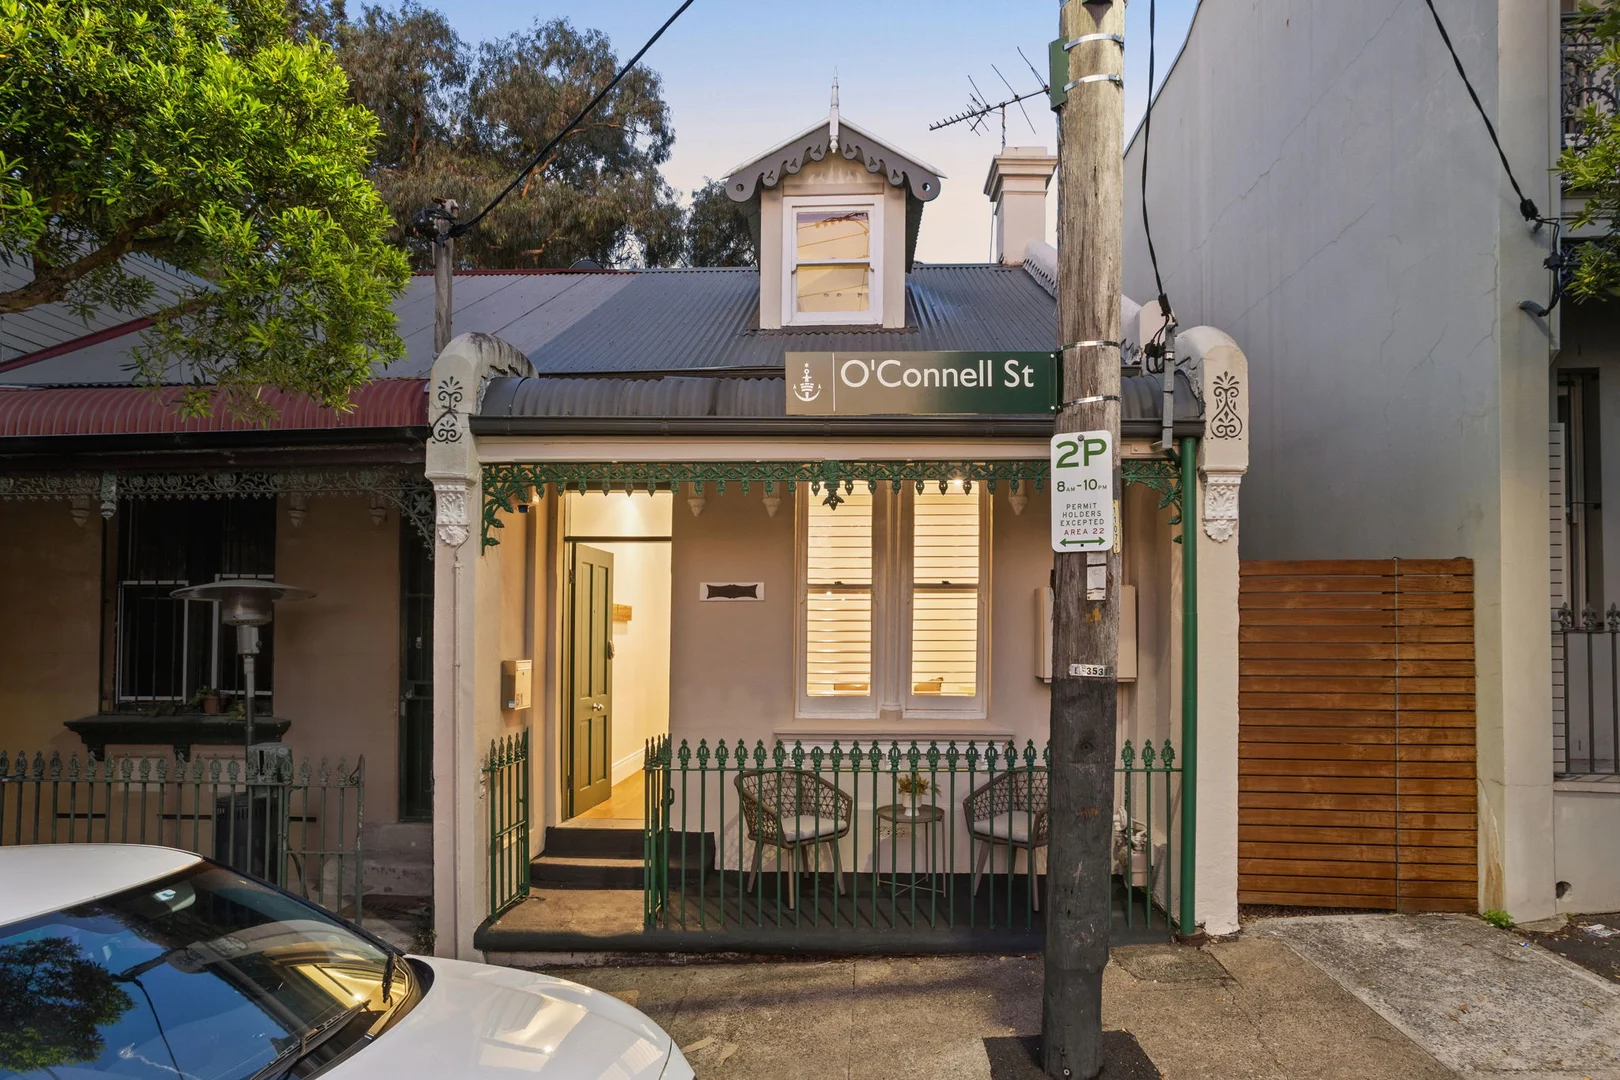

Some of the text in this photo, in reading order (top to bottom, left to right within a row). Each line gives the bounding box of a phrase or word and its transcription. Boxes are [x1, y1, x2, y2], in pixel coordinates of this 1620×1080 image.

[840, 359, 1035, 388] O'Connell St
[1056, 438, 1107, 469] 2P
[1066, 502, 1098, 511] PERMIT
[1062, 510, 1102, 519] HOLDERS
[1060, 518, 1105, 527] EXCEPTED
[1063, 527, 1105, 536] AREA 22
